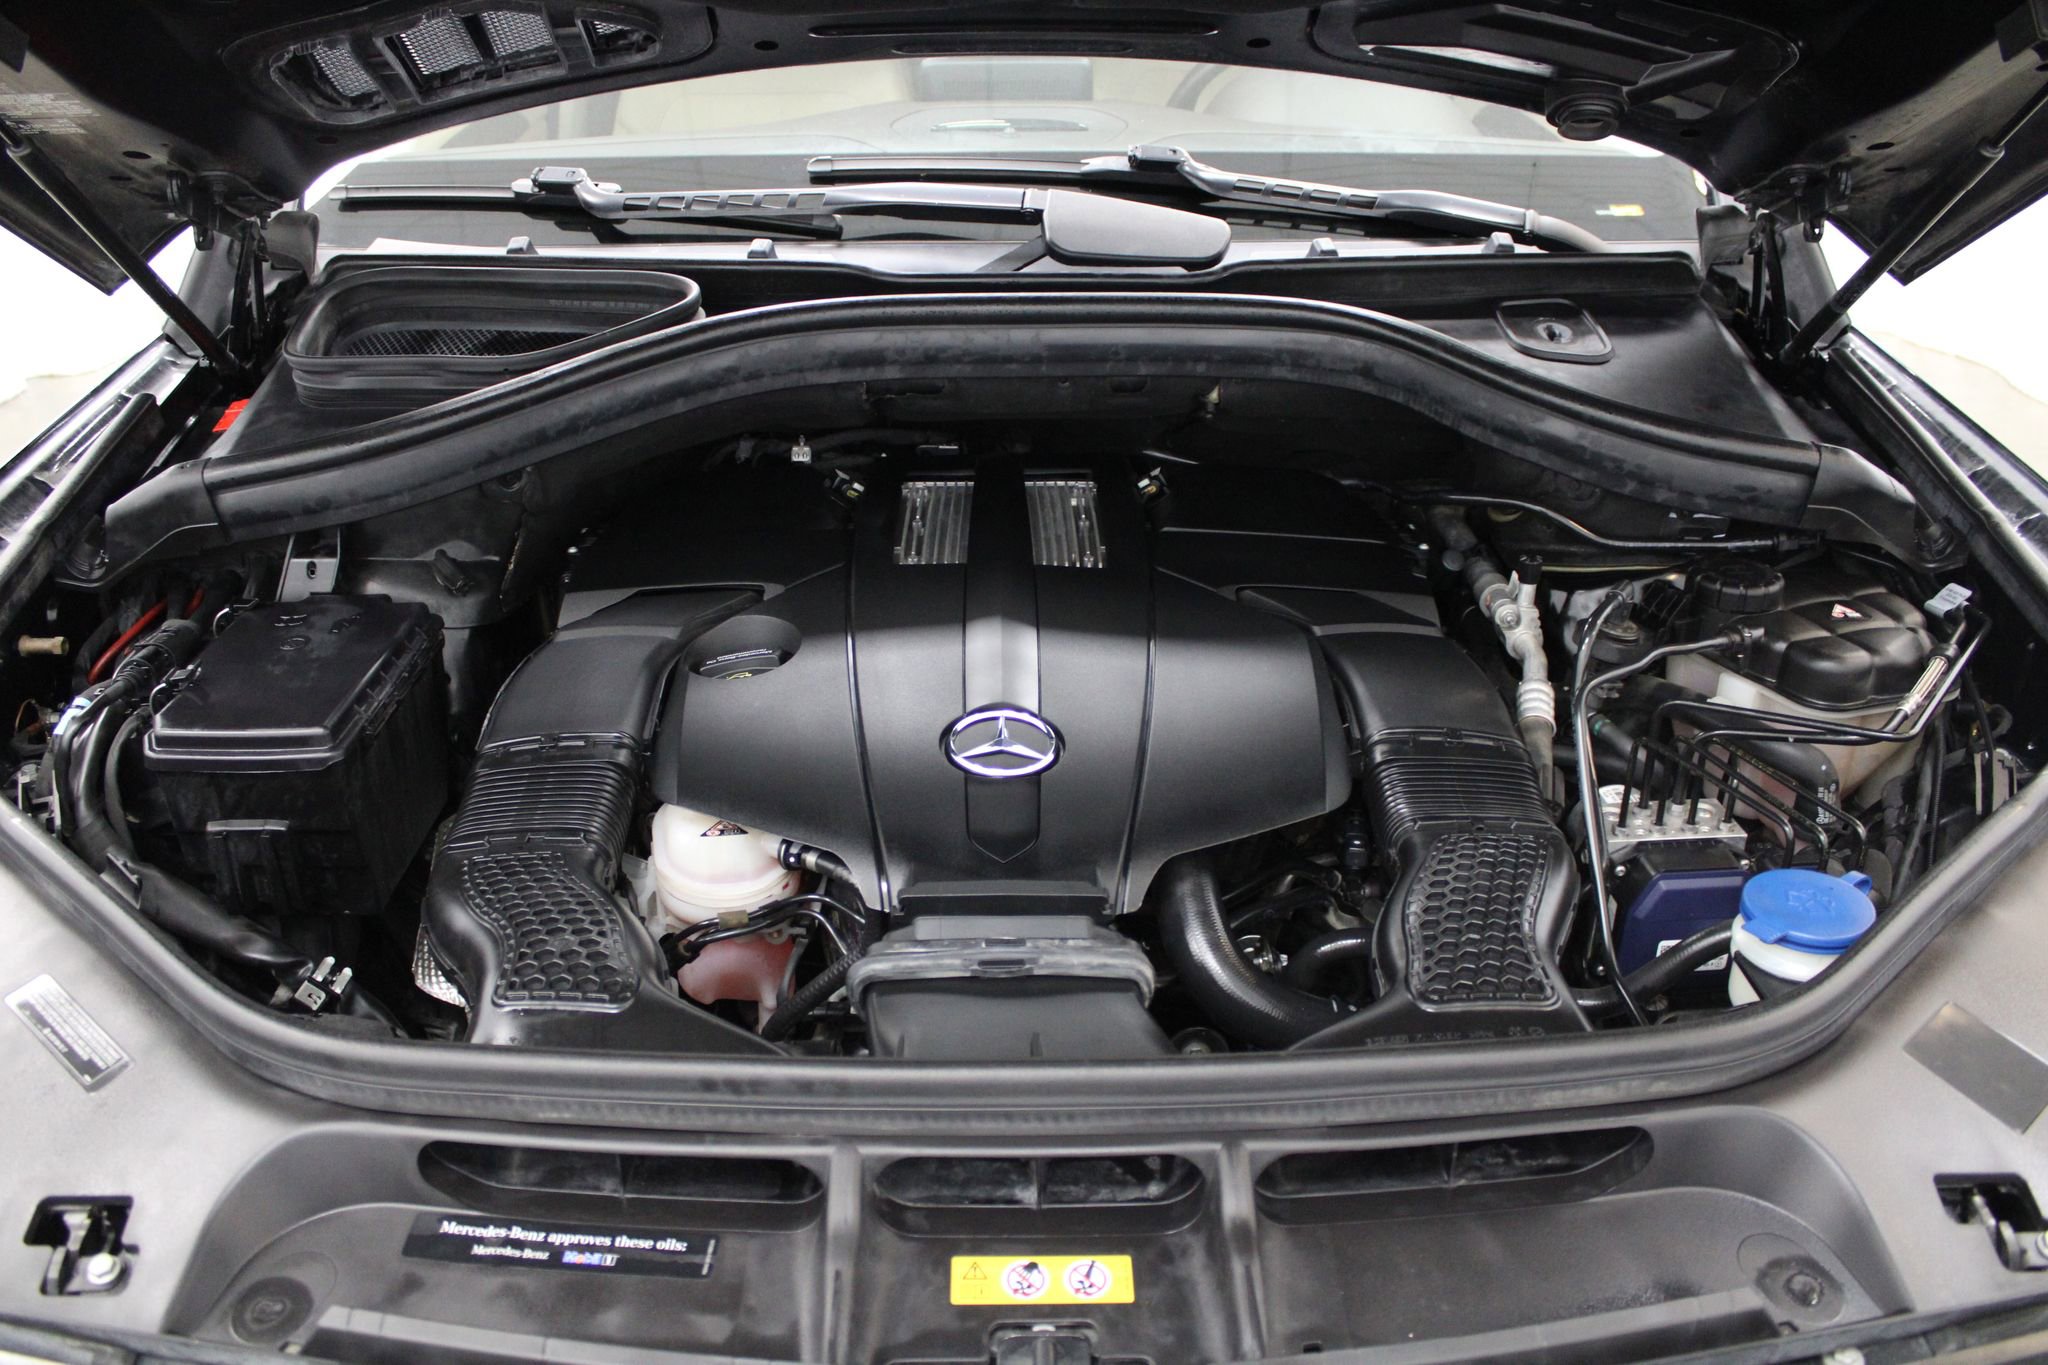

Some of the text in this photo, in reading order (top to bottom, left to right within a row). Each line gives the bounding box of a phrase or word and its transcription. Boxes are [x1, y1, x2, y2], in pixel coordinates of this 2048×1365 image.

[439, 1220, 688, 1252] Mercedes-Benz approves these oils:
[470, 1244, 550, 1260] Mercedes-Benz
